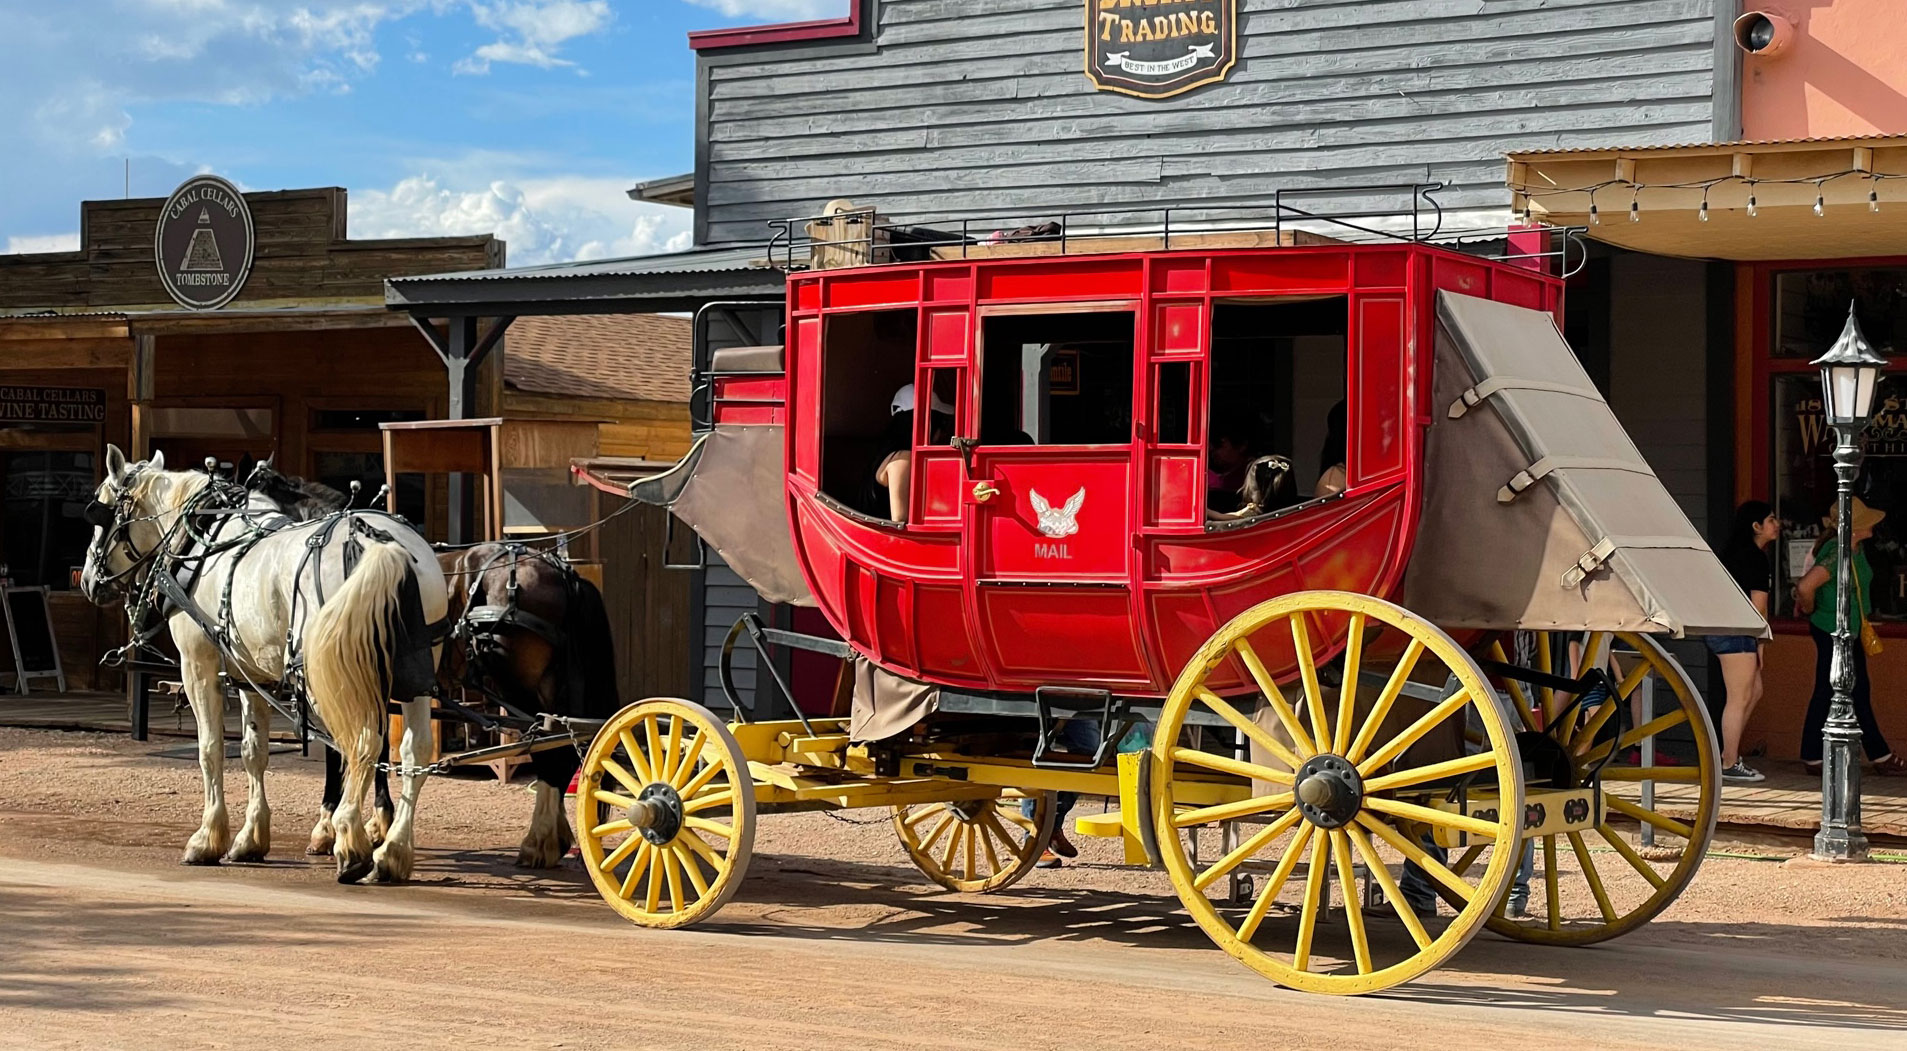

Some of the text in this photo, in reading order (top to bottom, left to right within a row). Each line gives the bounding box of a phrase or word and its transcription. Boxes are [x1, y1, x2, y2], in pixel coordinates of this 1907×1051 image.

[1124, 55, 1195, 72] BEST IN THE WEST
[170, 187, 240, 219] CABAL CELLARS
[176, 273, 230, 286] TOMBSTONE
[0, 387, 97, 402] CABAL CELLARS
[38, 403, 105, 420] TASTING
[1034, 543, 1073, 559] MAIL
